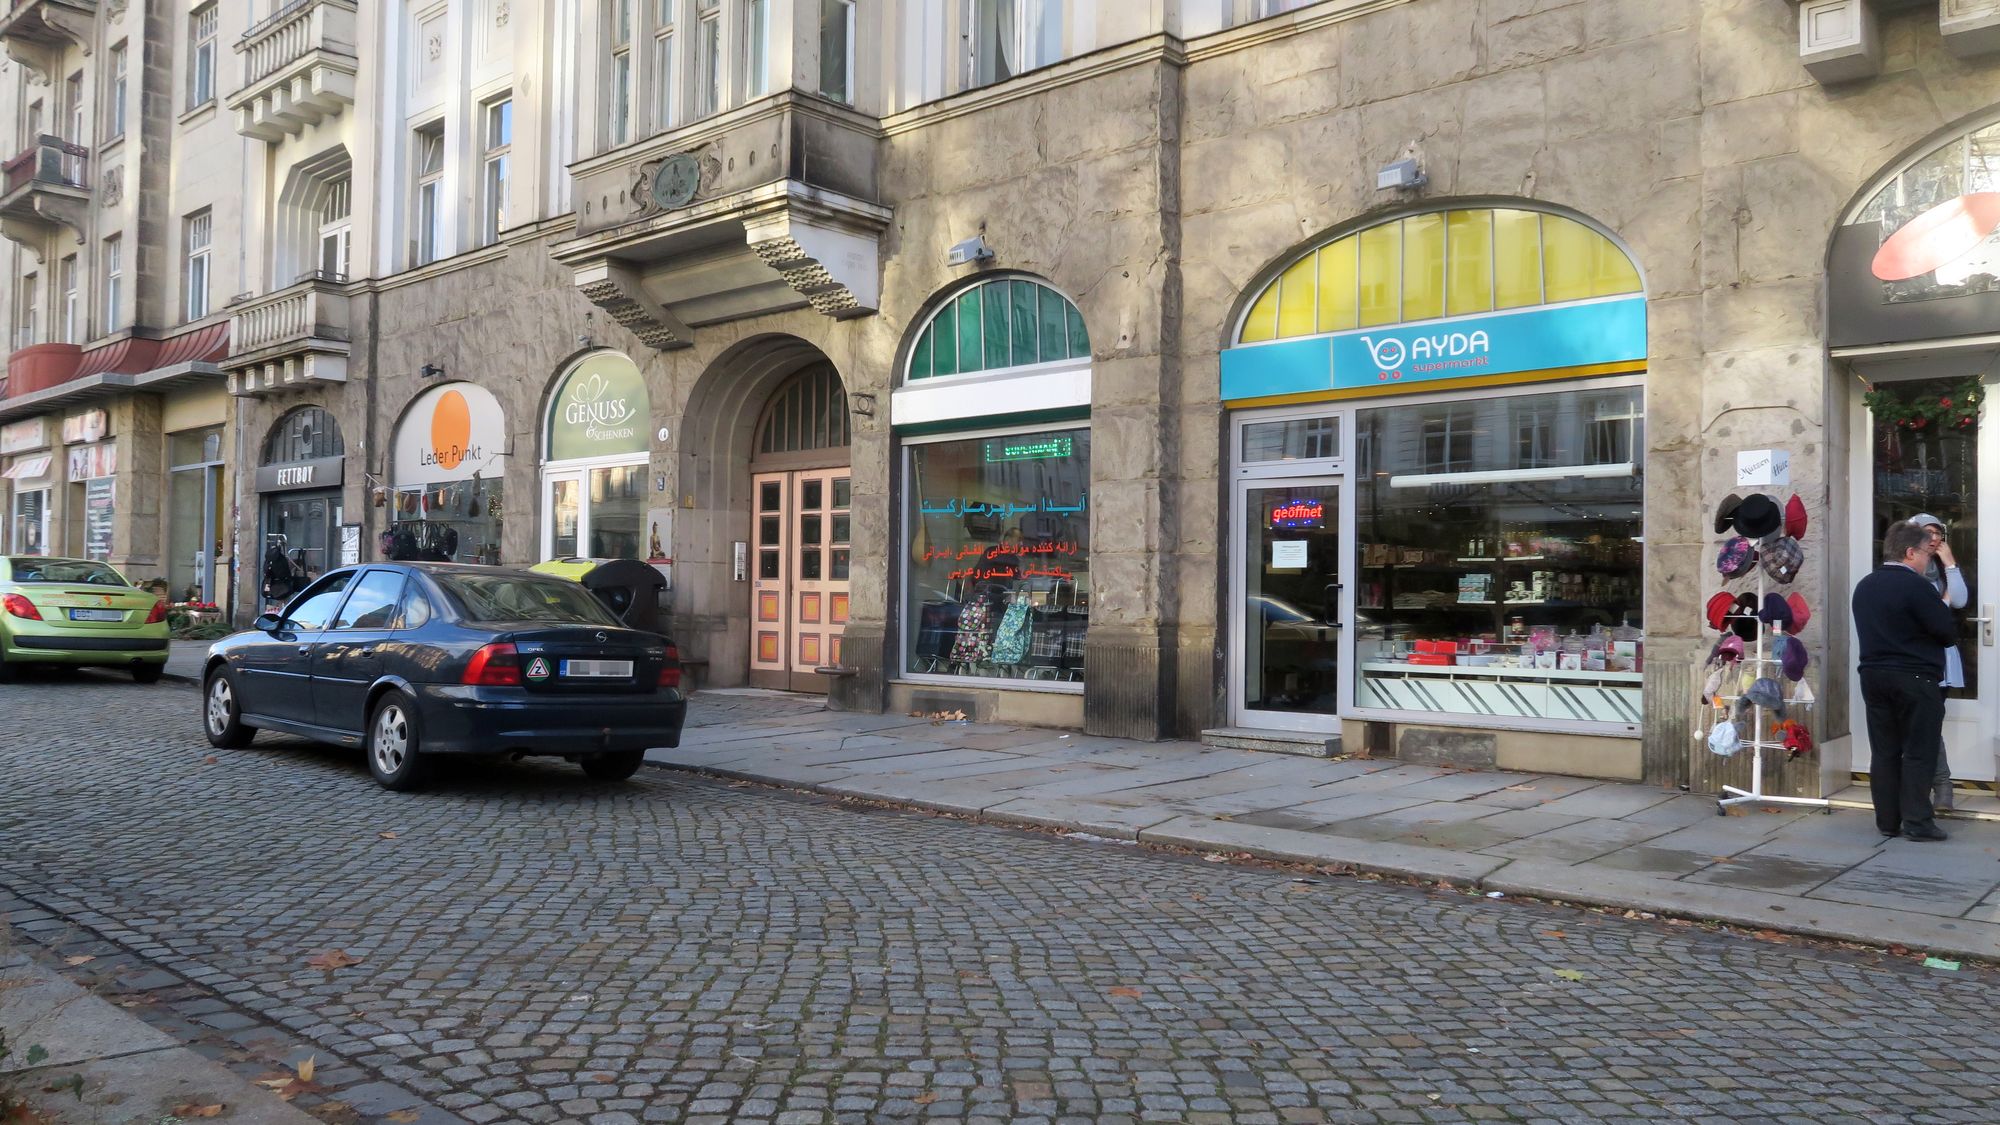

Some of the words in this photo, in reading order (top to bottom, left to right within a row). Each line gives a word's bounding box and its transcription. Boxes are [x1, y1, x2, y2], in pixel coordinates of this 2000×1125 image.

[1412, 330, 1489, 360] AYDA
[1412, 355, 1489, 373] supermarkt
[565, 398, 626, 425] GENUSS
[594, 427, 634, 441] SCHENKEN
[420, 447, 449, 466] Leder
[451, 443, 482, 463] Punkt
[277, 465, 314, 486] FETTBOY
[1273, 504, 1323, 521] geöffnet
[535, 665, 541, 674] Z
